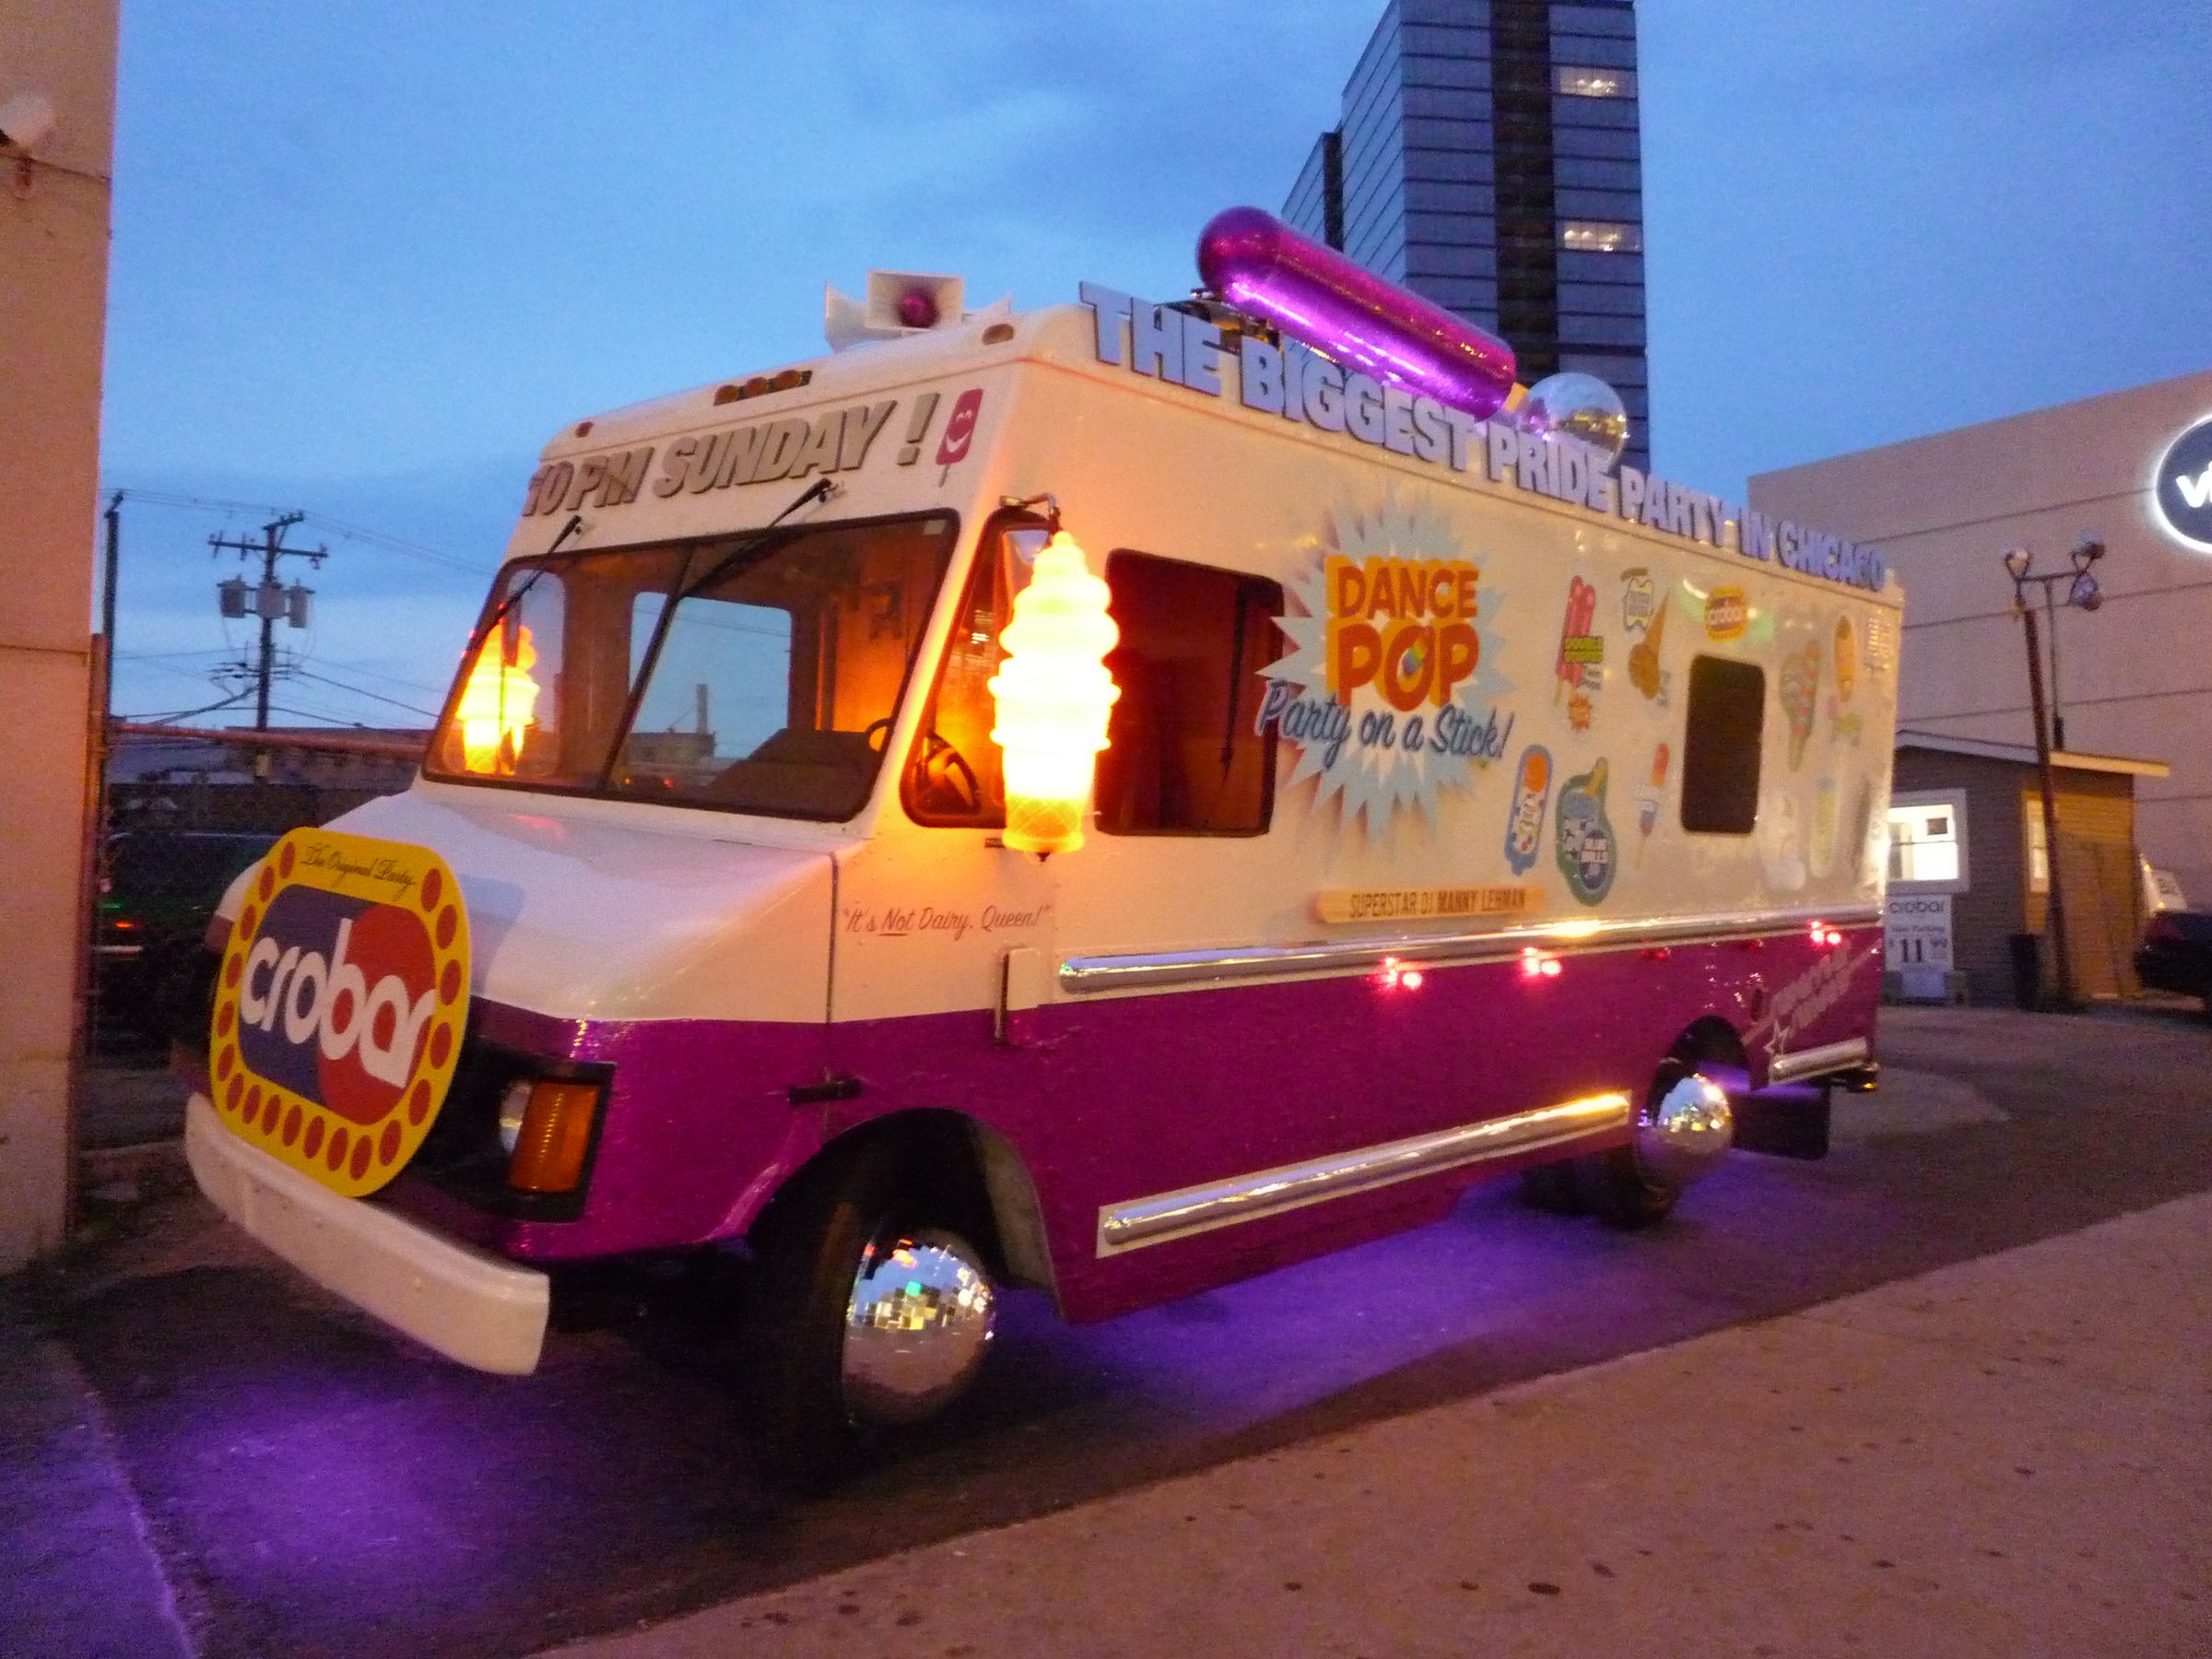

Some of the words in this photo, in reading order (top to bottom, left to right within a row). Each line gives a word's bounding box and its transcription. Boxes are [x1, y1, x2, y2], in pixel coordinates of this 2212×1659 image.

[1079, 280, 1221, 396] THE
[1241, 335, 1478, 473] BIGGEST
[1486, 420, 1614, 512] PRIDE
[1619, 464, 1728, 547] PARTY
[1738, 506, 1771, 561] IN
[1776, 519, 1886, 592] CHICAGO
[1336, 565, 1479, 620] DANCE
[1336, 623, 1480, 712] POP
[1254, 678, 1352, 771] Party
[1359, 709, 1396, 749] on
[1401, 714, 1425, 752] a
[1430, 702, 1516, 760] Stick!
[300, 842, 330, 866] The
[326, 851, 380, 888] Original
[374, 859, 417, 902] Party
[1349, 890, 1417, 918] SUPERSTAR
[880, 907, 915, 933] Not
[241, 917, 437, 1090] crobar
